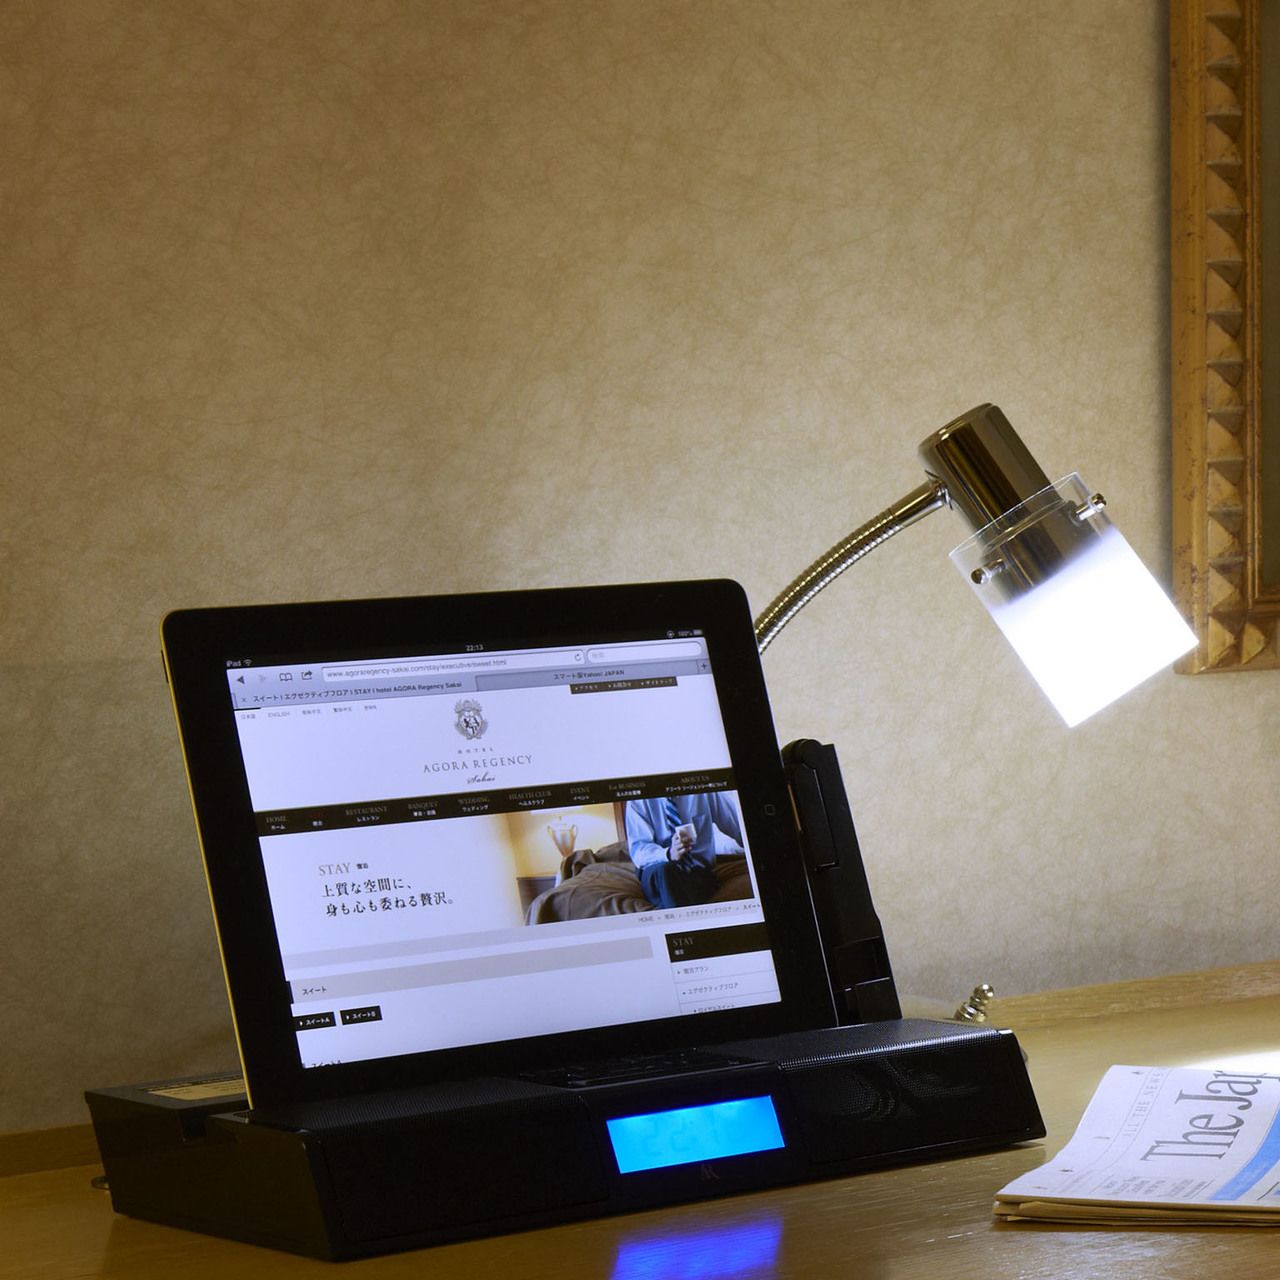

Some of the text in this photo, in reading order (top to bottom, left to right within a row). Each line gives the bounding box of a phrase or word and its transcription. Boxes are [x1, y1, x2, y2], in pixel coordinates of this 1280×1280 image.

[465, 643, 484, 652] 22:13
[354, 686, 372, 696] STAY
[393, 683, 416, 693] AGORA
[418, 681, 444, 692] Regency
[445, 680, 462, 689] Sakai
[423, 754, 533, 773] AGORA REGENCY
[466, 772, 496, 784] Sakai
[265, 815, 288, 823] HOME
[318, 862, 352, 876] STAY
[321, 877, 413, 898] 上質な空間に、
[326, 891, 454, 917] 身も心も委ねる贅沢。
[671, 936, 694, 946] STAY
[302, 986, 328, 996] スイート
[1140, 1112, 1245, 1162] The
